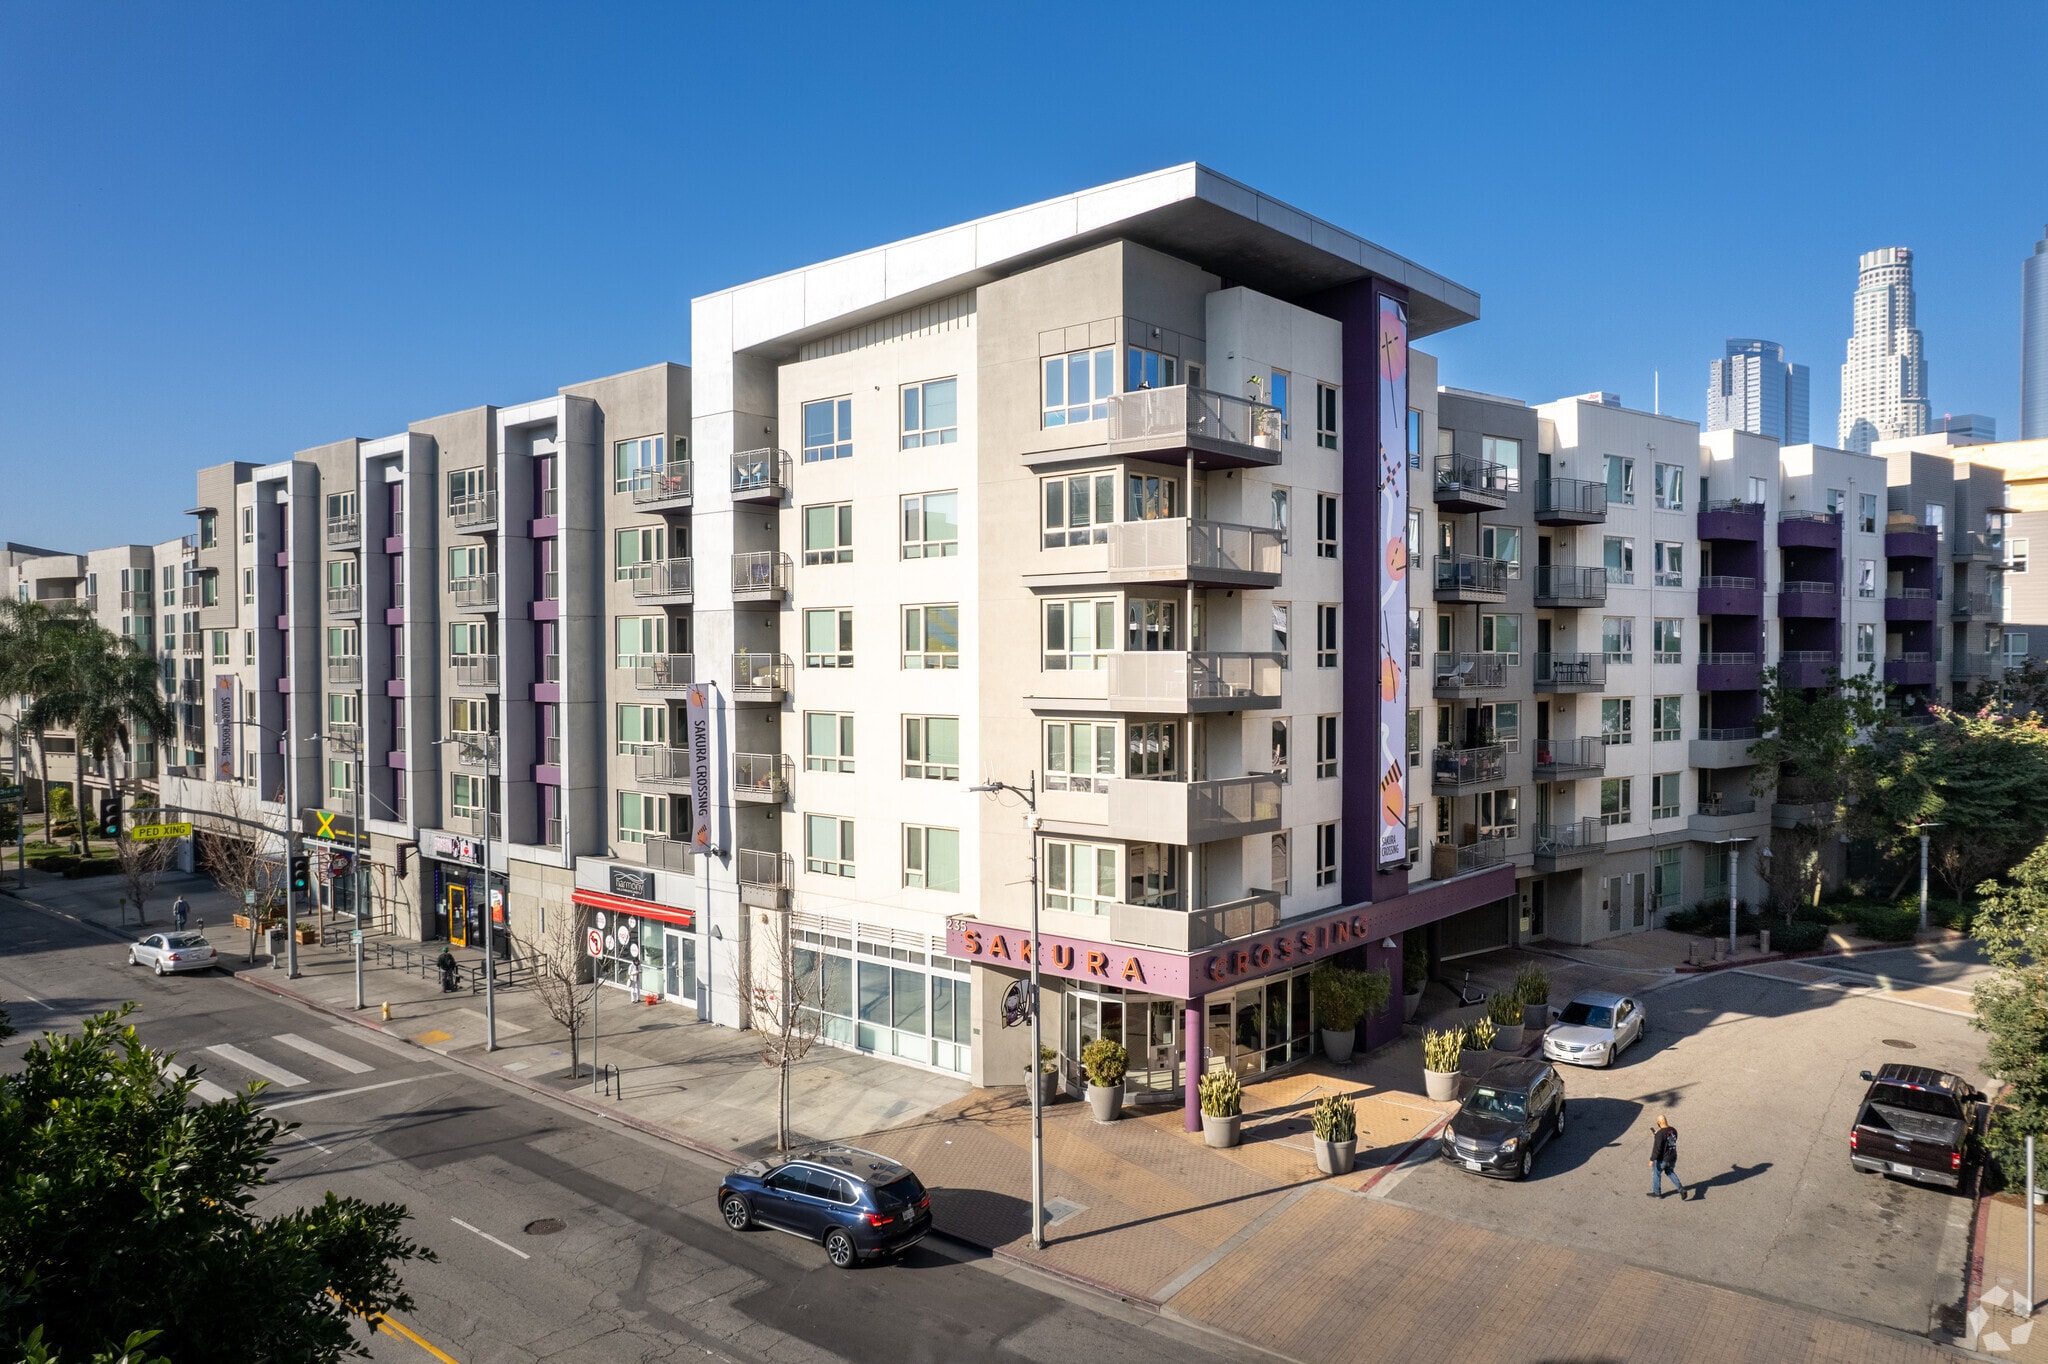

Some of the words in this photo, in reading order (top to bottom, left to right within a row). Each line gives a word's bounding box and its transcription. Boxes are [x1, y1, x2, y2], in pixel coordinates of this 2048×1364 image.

[221, 724, 231, 756] CROSSING
[694, 720, 707, 763] SAKURA
[696, 765, 708, 816] CROSSING
[139, 827, 160, 837] PED
[163, 825, 185, 835] XING
[1381, 834, 1397, 846] SAKURA
[1381, 844, 1399, 857] CROSSING
[946, 919, 967, 932] 235
[963, 930, 1147, 984] SAKURA
[1209, 915, 1369, 983] CROSSING
